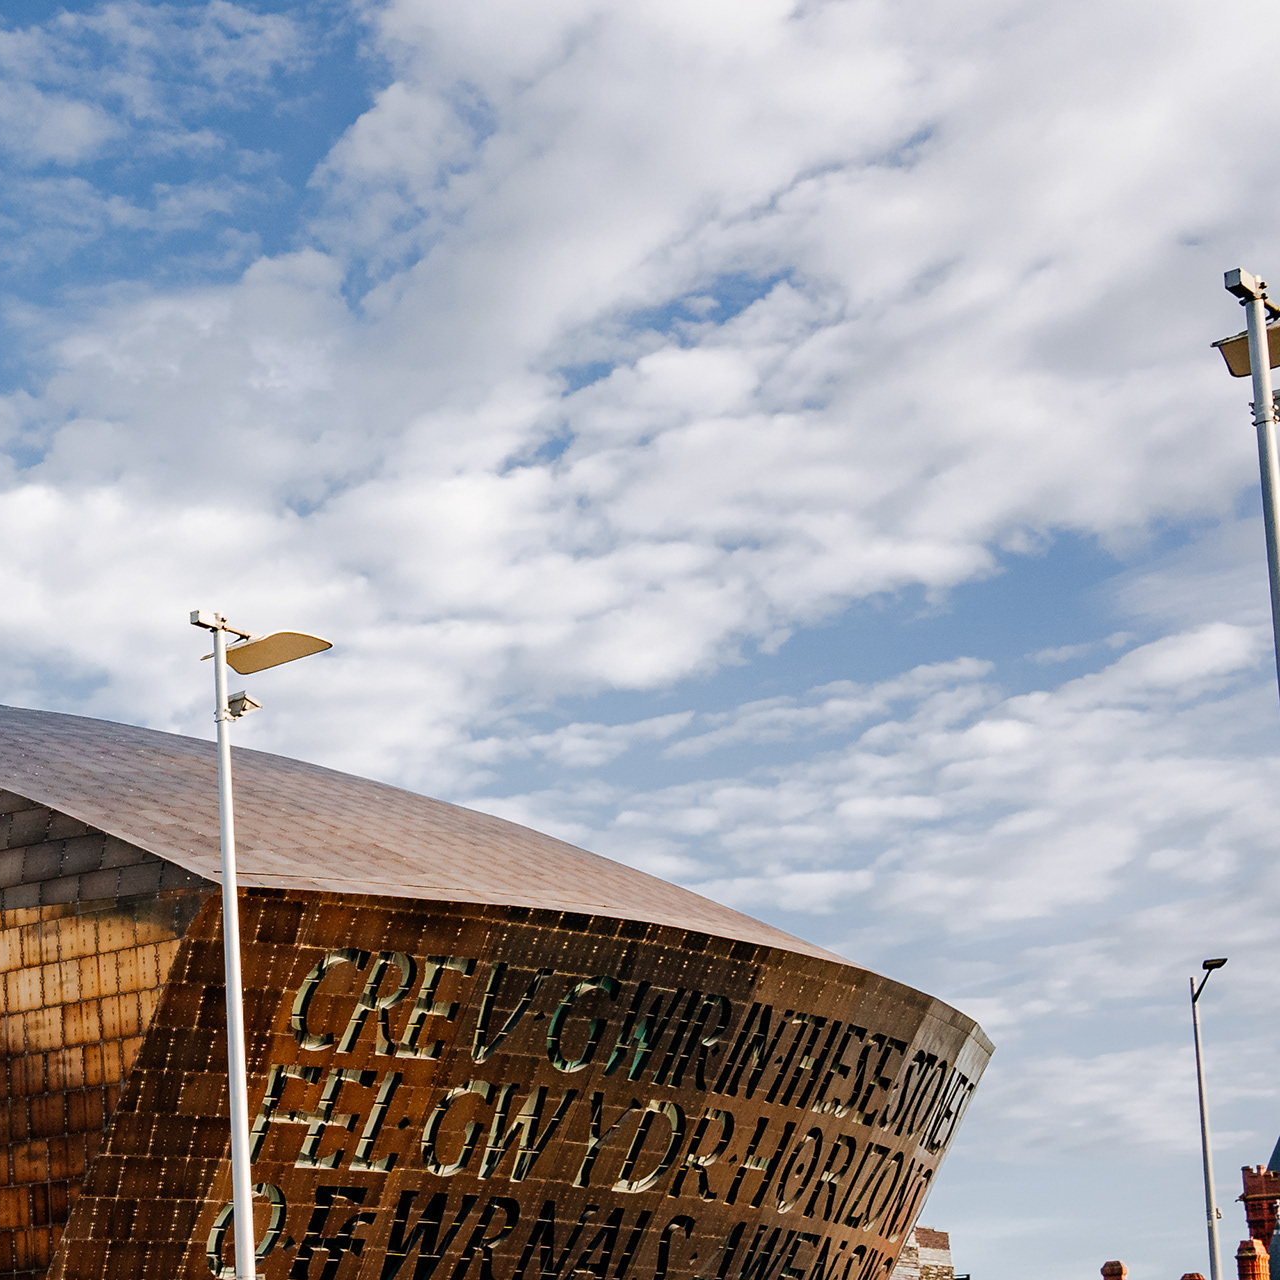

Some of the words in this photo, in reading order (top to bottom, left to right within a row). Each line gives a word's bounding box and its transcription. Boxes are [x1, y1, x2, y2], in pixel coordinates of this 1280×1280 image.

[546, 975, 732, 1092] GWIR
[763, 1009, 909, 1126] THESE
[250, 1064, 403, 1173] FEL
[421, 1079, 735, 1203] GWYDR
[723, 1117, 932, 1244] HORIZONS
